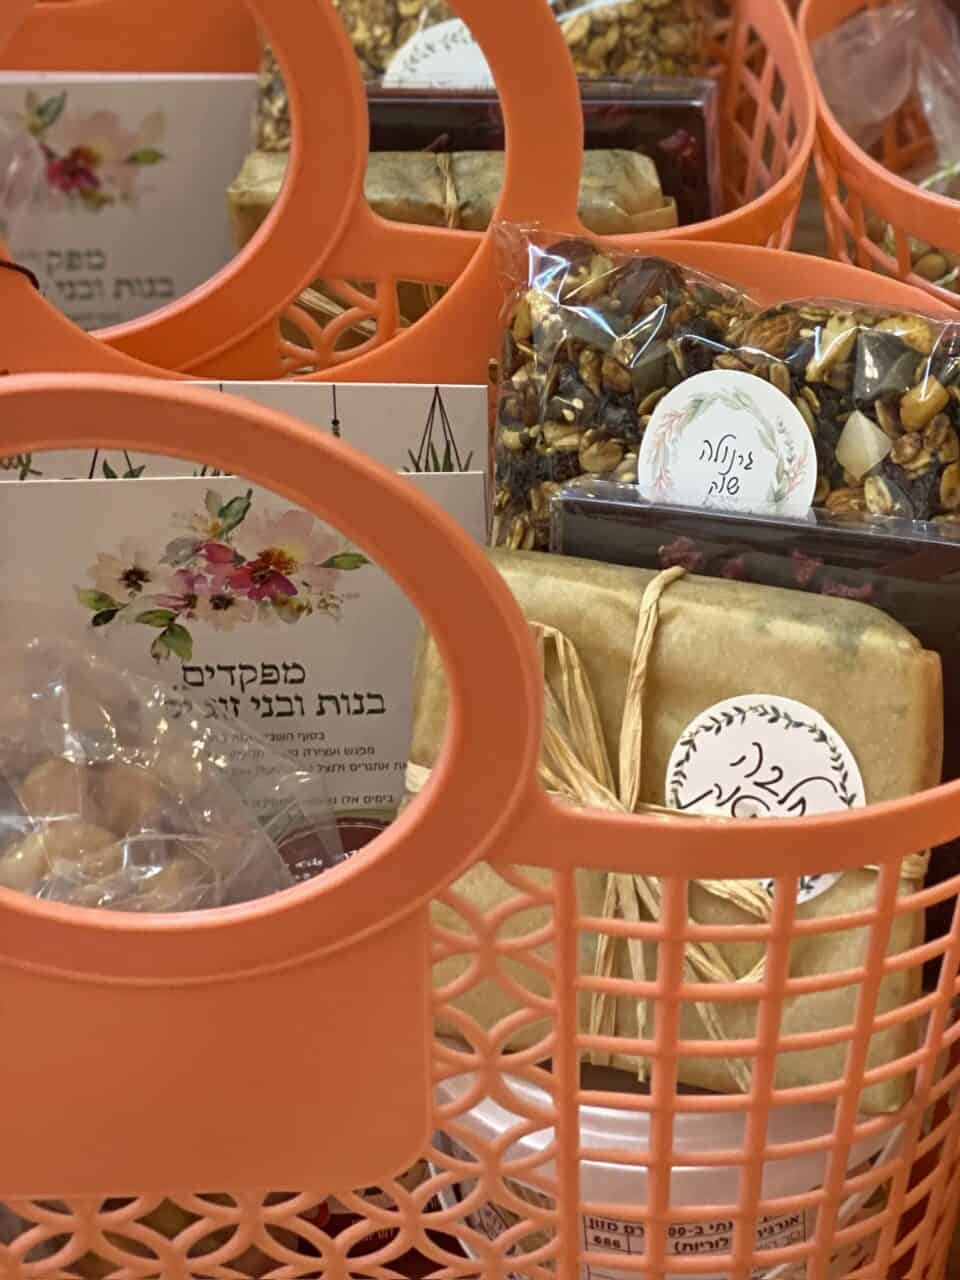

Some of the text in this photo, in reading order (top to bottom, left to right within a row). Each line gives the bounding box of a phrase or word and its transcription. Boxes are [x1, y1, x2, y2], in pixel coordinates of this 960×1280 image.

[250, 694, 305, 718] ובני
[315, 691, 387, 716] בנות
[674, 1237, 730, 1255] לוריות)
